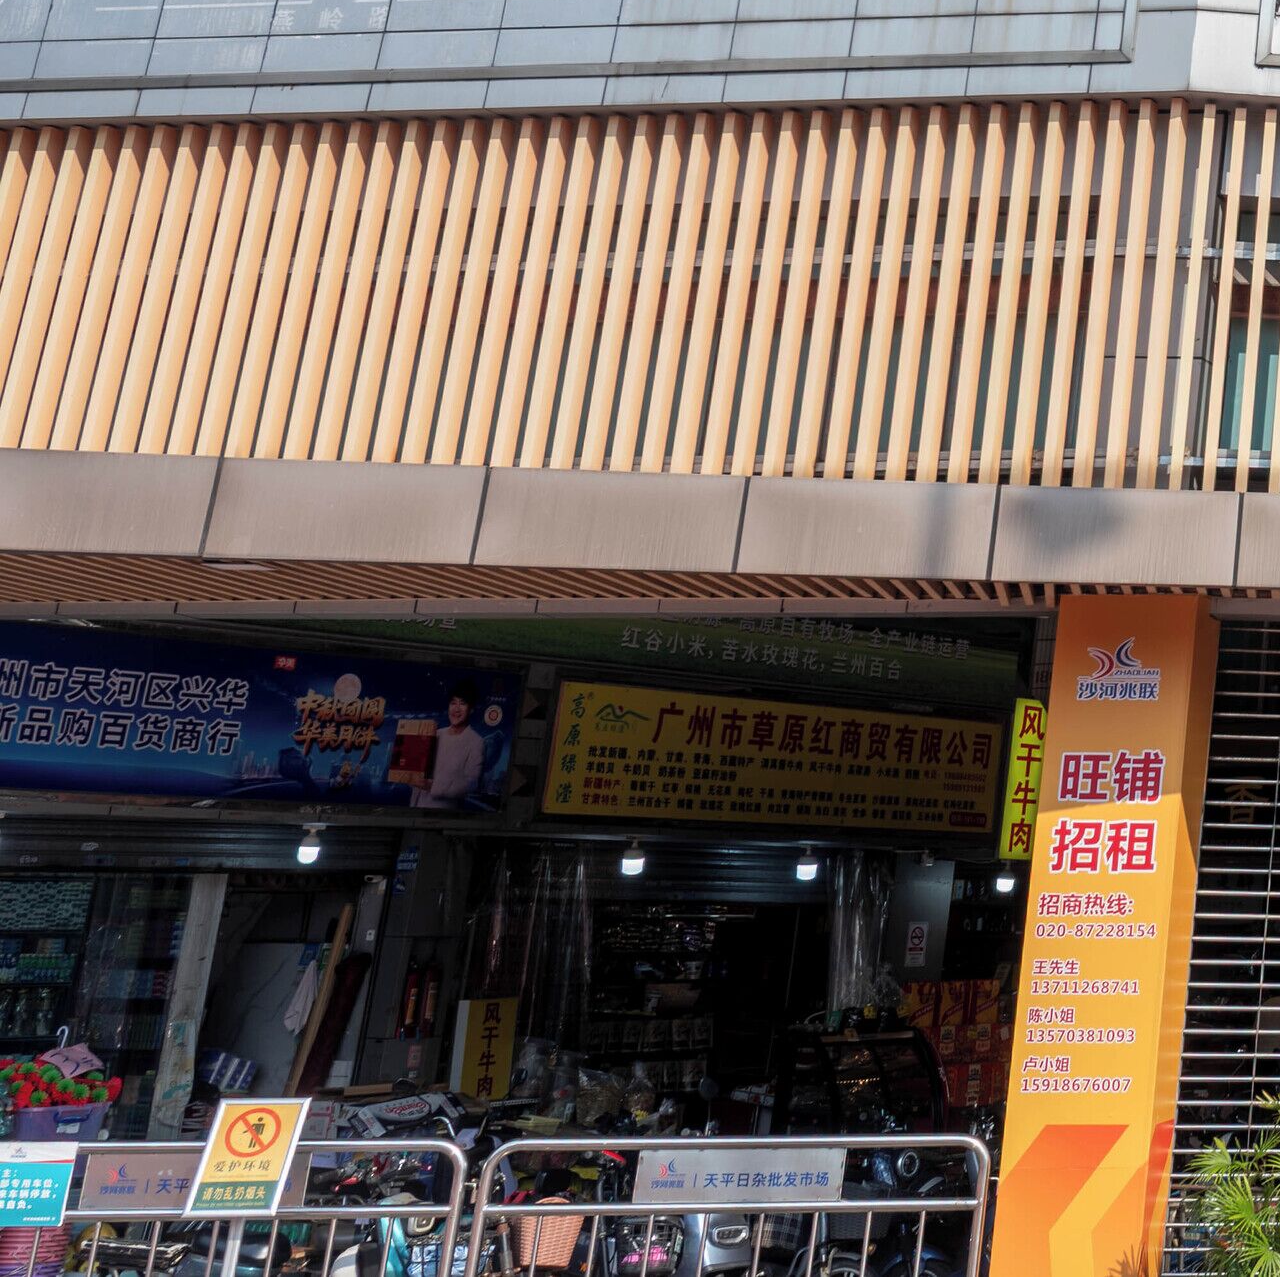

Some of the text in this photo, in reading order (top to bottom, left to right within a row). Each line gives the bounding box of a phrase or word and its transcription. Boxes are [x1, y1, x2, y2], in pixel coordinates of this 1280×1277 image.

[1077, 680, 1159, 701] 沙河兆联
[652, 701, 993, 770] 广州市草原红商贸有限公司
[1006, 703, 1045, 854] 风干牛肉
[1058, 749, 1165, 804] 旺铺
[1049, 819, 1157, 875] 招租
[1037, 892, 1135, 917] 招商热线:
[1034, 920, 1157, 939] 020-87228154
[1032, 959, 1080, 976] 王先生
[1030, 978, 1141, 996] 13711268741
[1027, 1007, 1075, 1025] 陈小姐
[1024, 1026, 1137, 1045] 13570381093
[476, 1002, 502, 1097] 风干牛肉
[1021, 1056, 1071, 1074] 卢小姐
[1020, 1076, 1132, 1094] 15918676007
[213, 1159, 273, 1173] 爱护环境
[703, 1170, 830, 1188] 天平日杂批发市场
[202, 1185, 267, 1202] 请勿乱扔烟头
